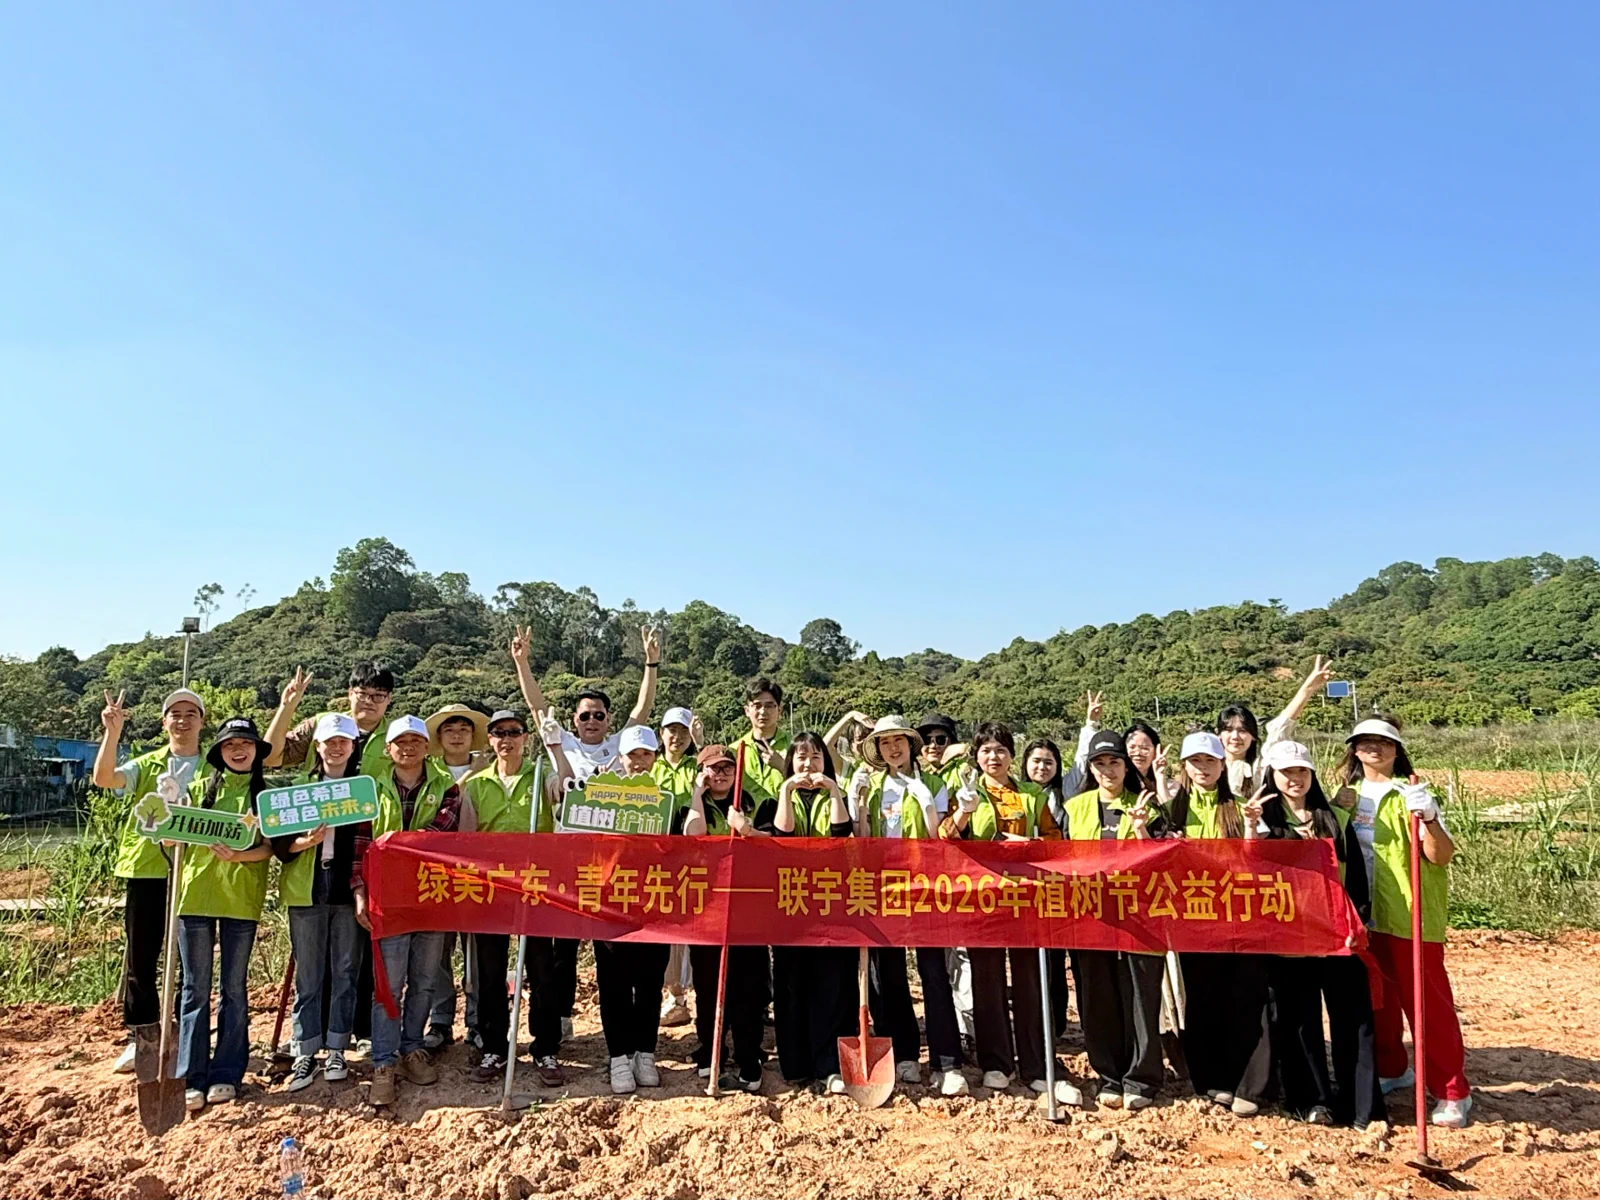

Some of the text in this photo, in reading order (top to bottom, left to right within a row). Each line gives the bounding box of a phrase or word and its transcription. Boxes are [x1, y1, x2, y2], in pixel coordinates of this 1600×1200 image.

[270, 782, 352, 810] 绿色希望
[590, 790, 658, 803] HAPPY SPRING
[278, 799, 360, 826] 绿色未来
[567, 803, 664, 834] 植树护林
[167, 813, 243, 841] 升植加薪
